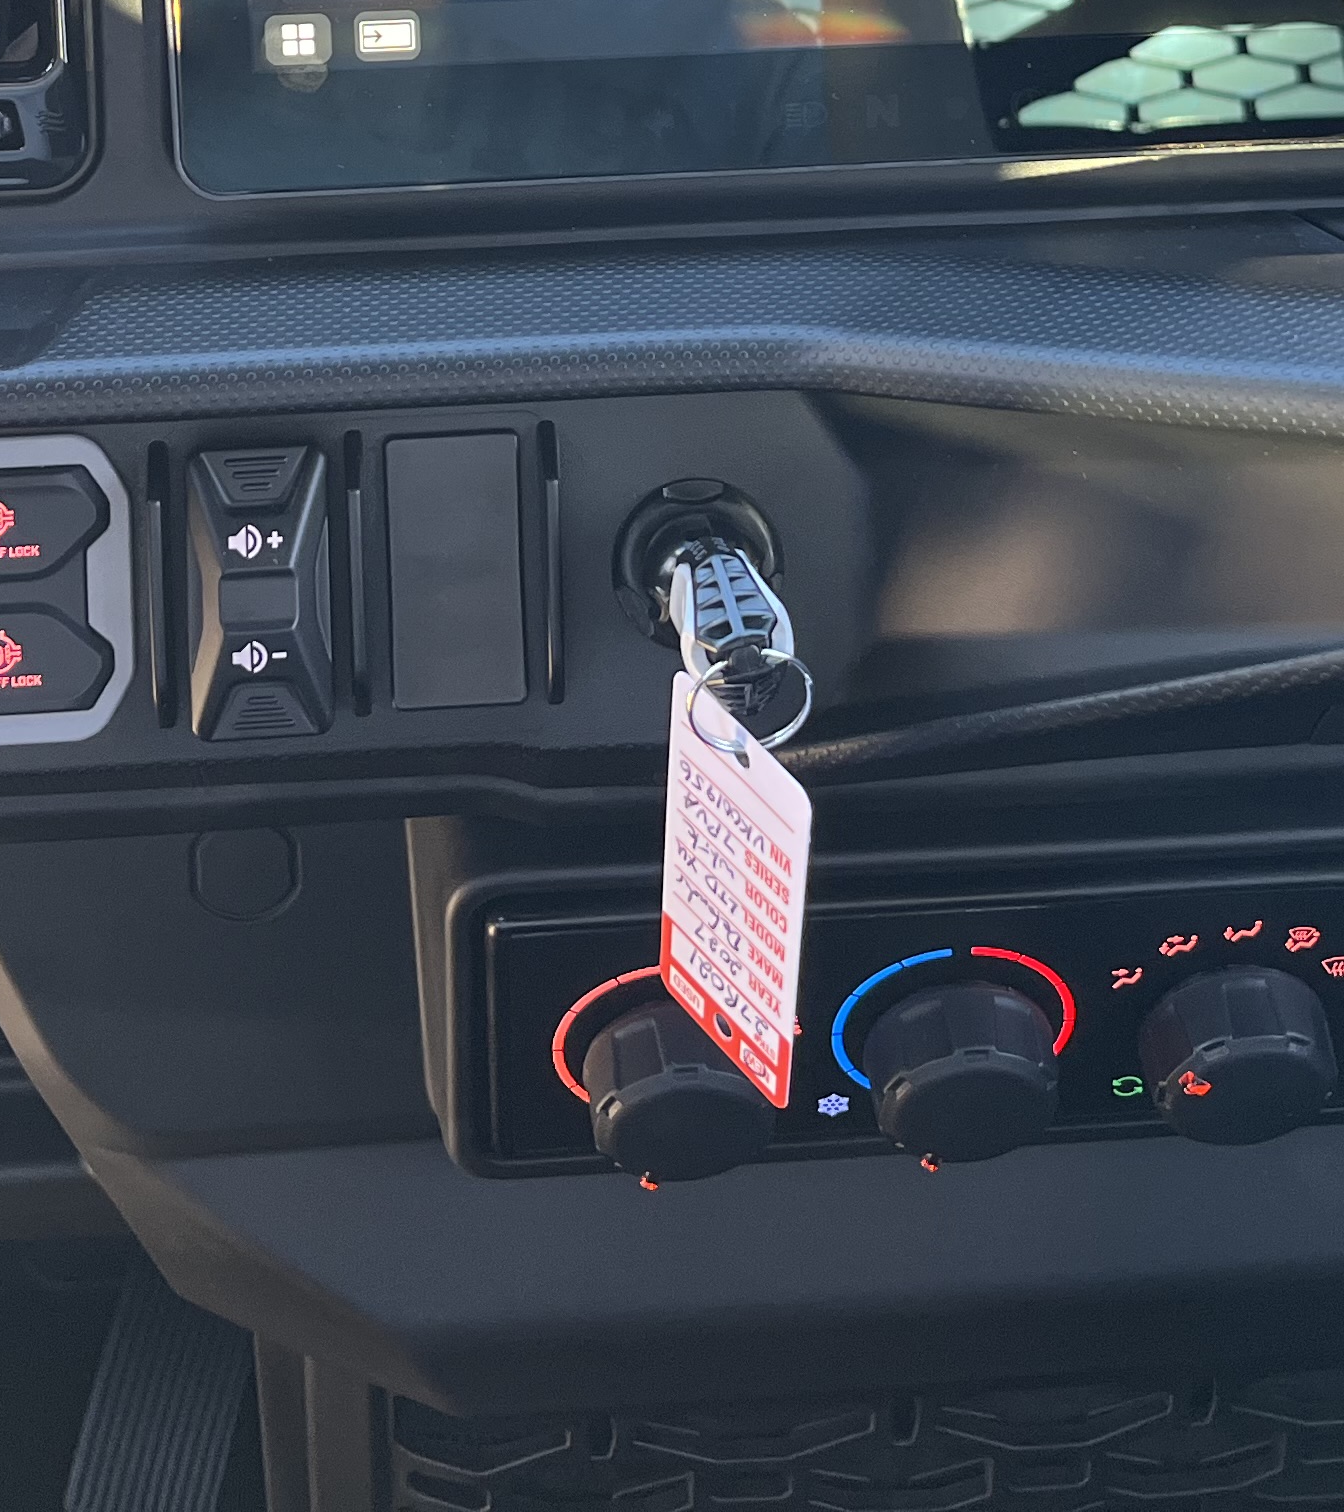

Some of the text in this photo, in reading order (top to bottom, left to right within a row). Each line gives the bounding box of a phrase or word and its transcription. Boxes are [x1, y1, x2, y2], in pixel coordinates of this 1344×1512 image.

[9, 545, 39, 558] LOCK
[11, 675, 42, 687] LOCK
[744, 849, 789, 905] SERIES
[770, 842, 792, 877] VIN
[705, 874, 738, 914] LTD
[745, 878, 787, 933] COLOR
[742, 904, 785, 962] MODEL
[695, 921, 781, 1019] YEAR 2027
[748, 942, 783, 990] MAKE
[673, 974, 700, 1010] USED
